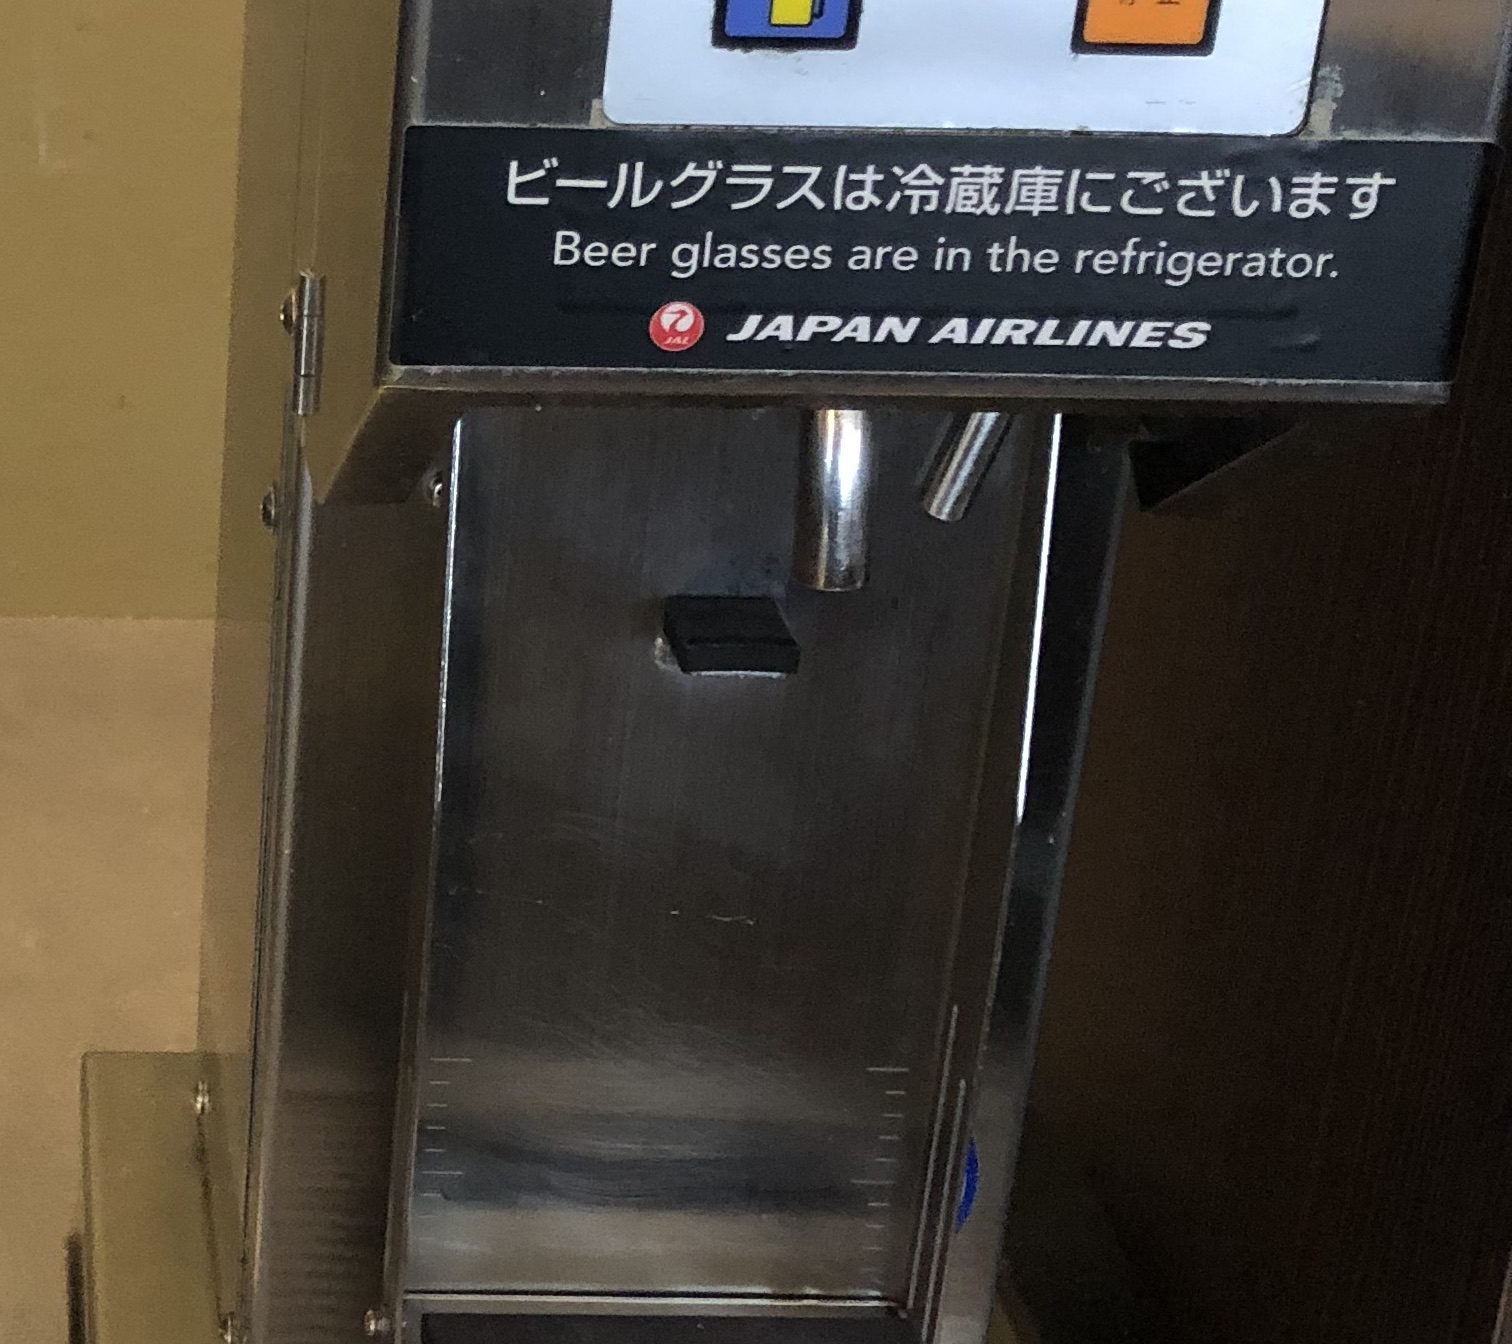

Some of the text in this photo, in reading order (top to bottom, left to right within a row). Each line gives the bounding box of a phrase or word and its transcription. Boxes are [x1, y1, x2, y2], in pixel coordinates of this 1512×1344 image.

[505, 157, 1396, 219] ビールグラスは冷蔵庫にございます
[552, 231, 1340, 288] Beer glasses are in the refrigerator.
[725, 314, 1212, 350] JAPAN AIRLINES
